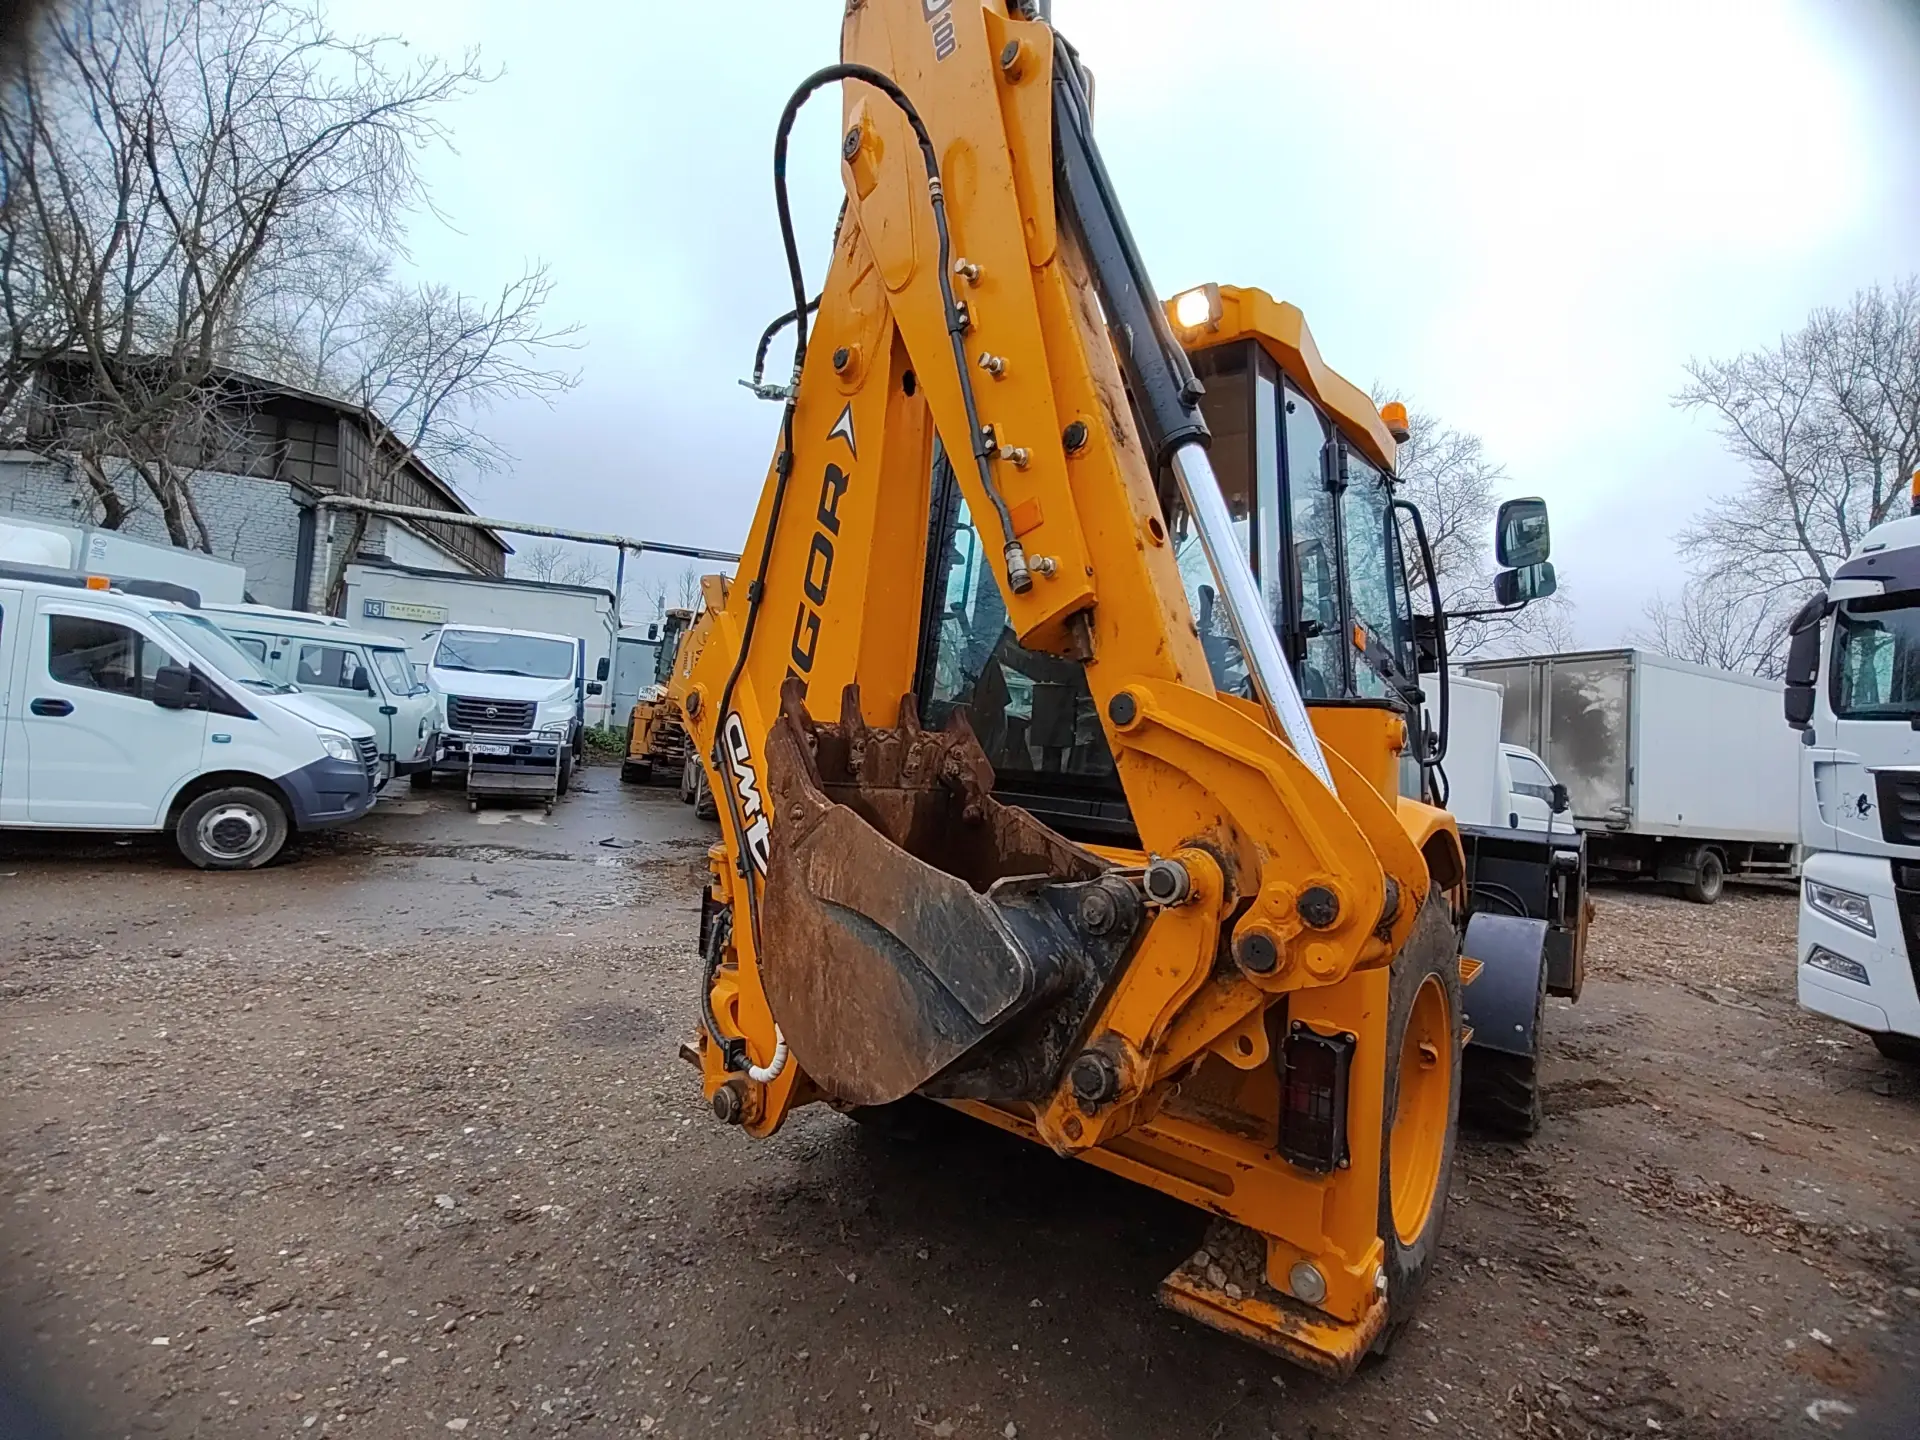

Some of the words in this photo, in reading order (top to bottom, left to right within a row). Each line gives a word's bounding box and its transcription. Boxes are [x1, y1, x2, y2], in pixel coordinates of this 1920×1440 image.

[931, 12, 956, 63] 100
[367, 603, 380, 615] 15
[725, 711, 773, 880] 4WD
